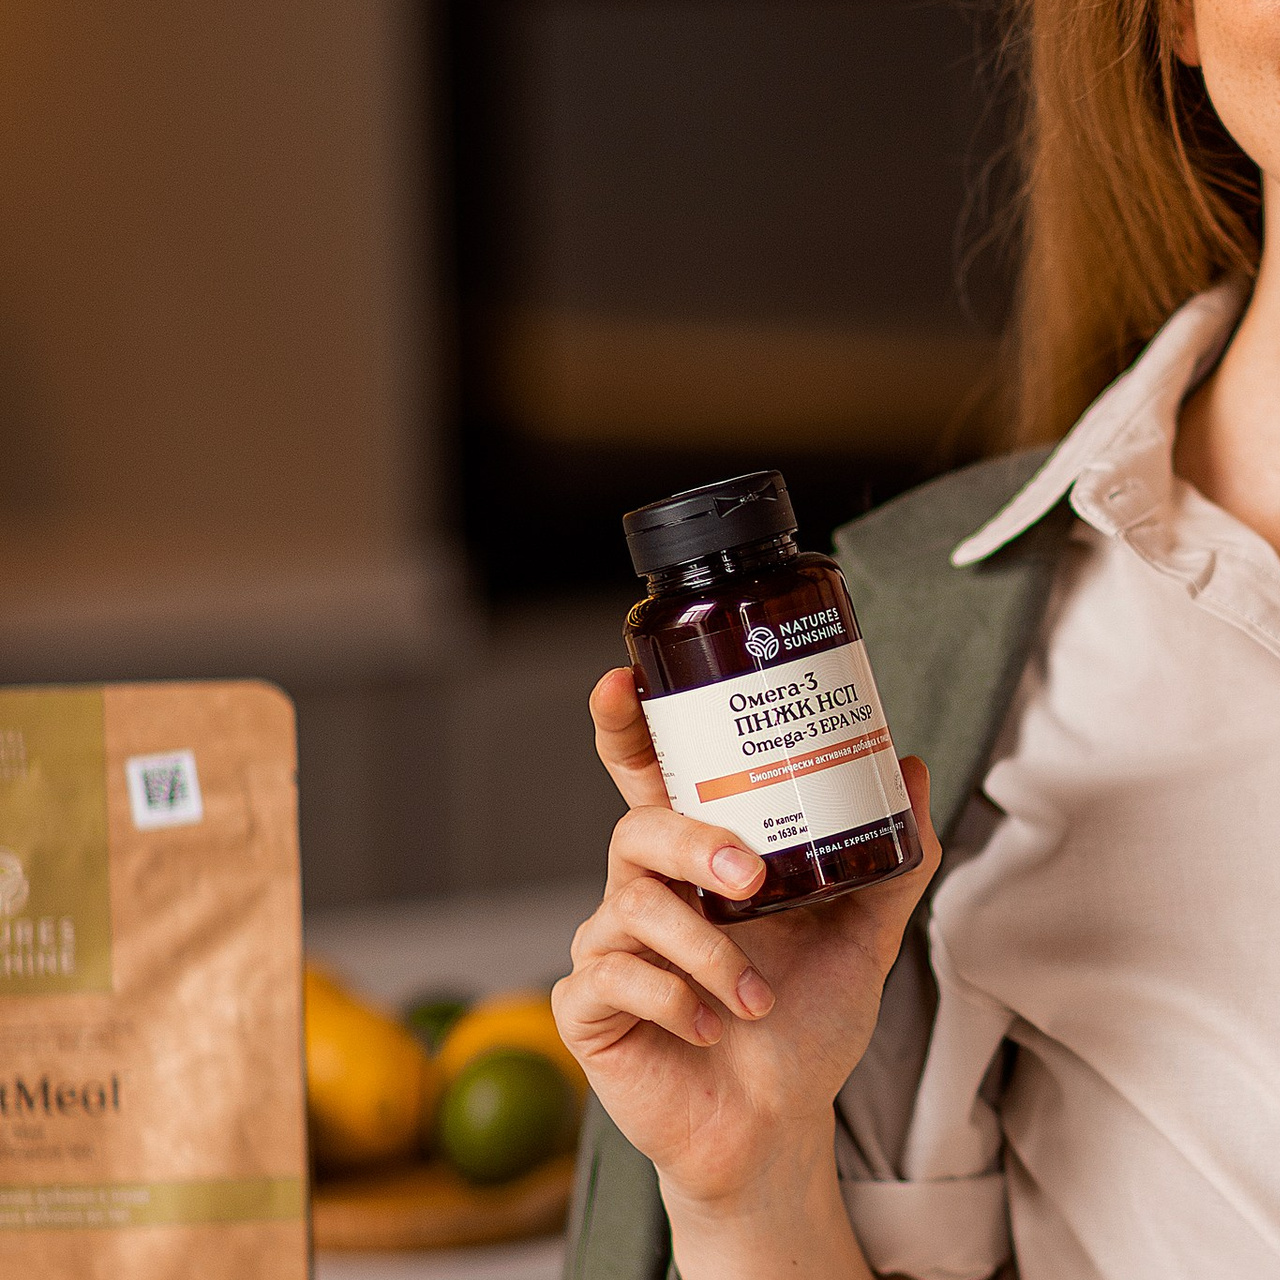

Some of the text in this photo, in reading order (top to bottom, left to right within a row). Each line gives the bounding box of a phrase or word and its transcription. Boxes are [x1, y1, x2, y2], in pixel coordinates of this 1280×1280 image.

[729, 671, 818, 713] Омега-3
[734, 684, 859, 737] ПНЖК НСП
[742, 704, 873, 756] Omega-3 EPA NSP
[749, 757, 814, 784] Биологически
[815, 747, 852, 765] активная
[763, 811, 804, 829] 60 капсул
[767, 834, 778, 843] по
[778, 825, 798, 840] 1638
[805, 841, 843, 859] HERBAL
[844, 830, 879, 848] EXPERTS
